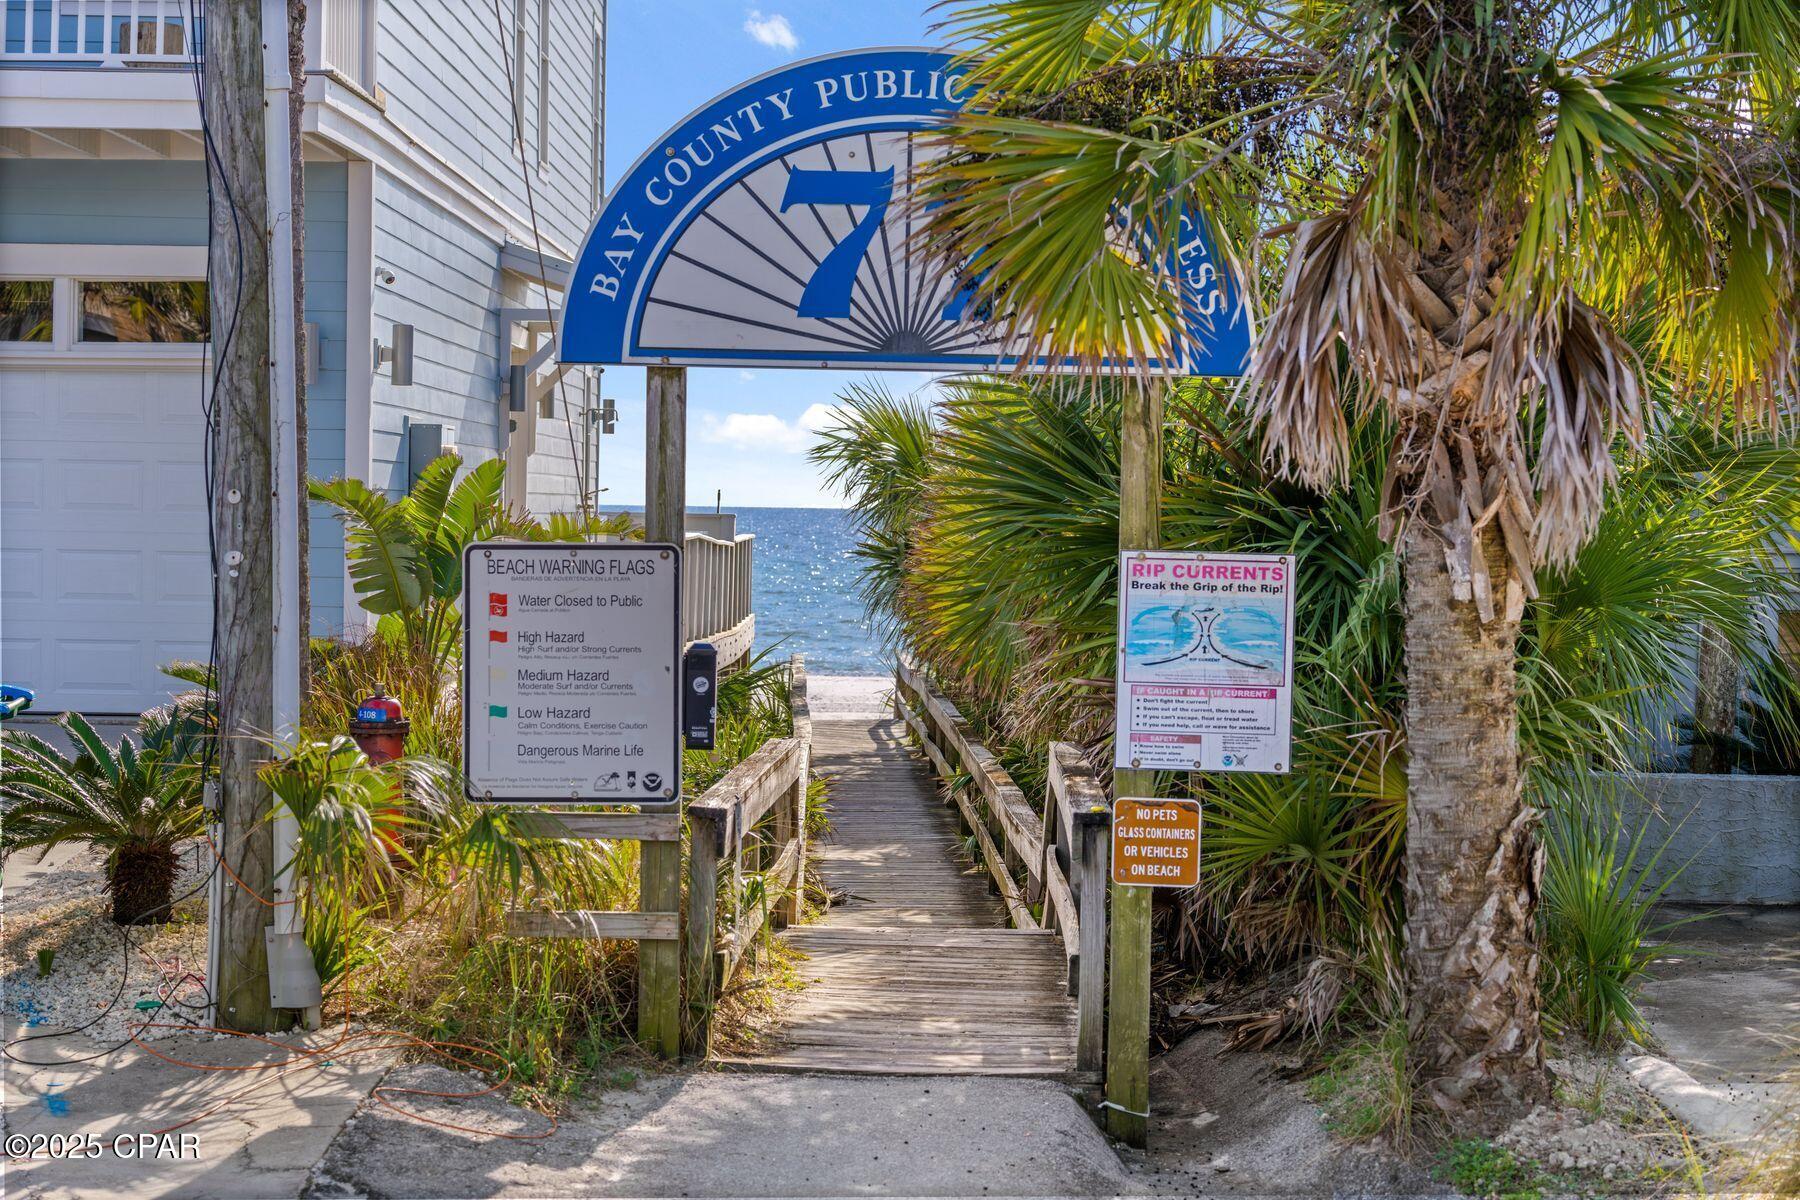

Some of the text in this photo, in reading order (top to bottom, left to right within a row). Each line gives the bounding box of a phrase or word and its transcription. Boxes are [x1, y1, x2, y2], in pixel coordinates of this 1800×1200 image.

[589, 69, 966, 302] BAY COUNTY PUBLIC
[487, 559, 655, 575] BEACH WARNING FLAGS
[1132, 564, 1284, 581] RIP CURRENTS
[1131, 581, 1284, 595] Break the Grip of the Rip!
[518, 594, 643, 607] Water Closed to Public
[517, 631, 584, 646] High Hazard
[517, 645, 642, 655] High Surf and/or Strong Currents
[517, 669, 609, 682] Medium Hazard
[517, 682, 633, 690] Moderate Surf and/or Currents
[1147, 688, 1184, 696] CAUGHT
[1225, 690, 1268, 698] CURRENT
[517, 707, 591, 719] Low Hazard
[517, 722, 648, 730] Calm Conditions, Exercise Caution
[517, 744, 644, 760] Dangerous Marine Life
[1136, 809, 1178, 821] NO PETS
[1118, 827, 1196, 840] GLASS CONTAINERS
[1124, 846, 1189, 859] OR VEHICLES
[1131, 864, 1181, 877] ON BEACH
